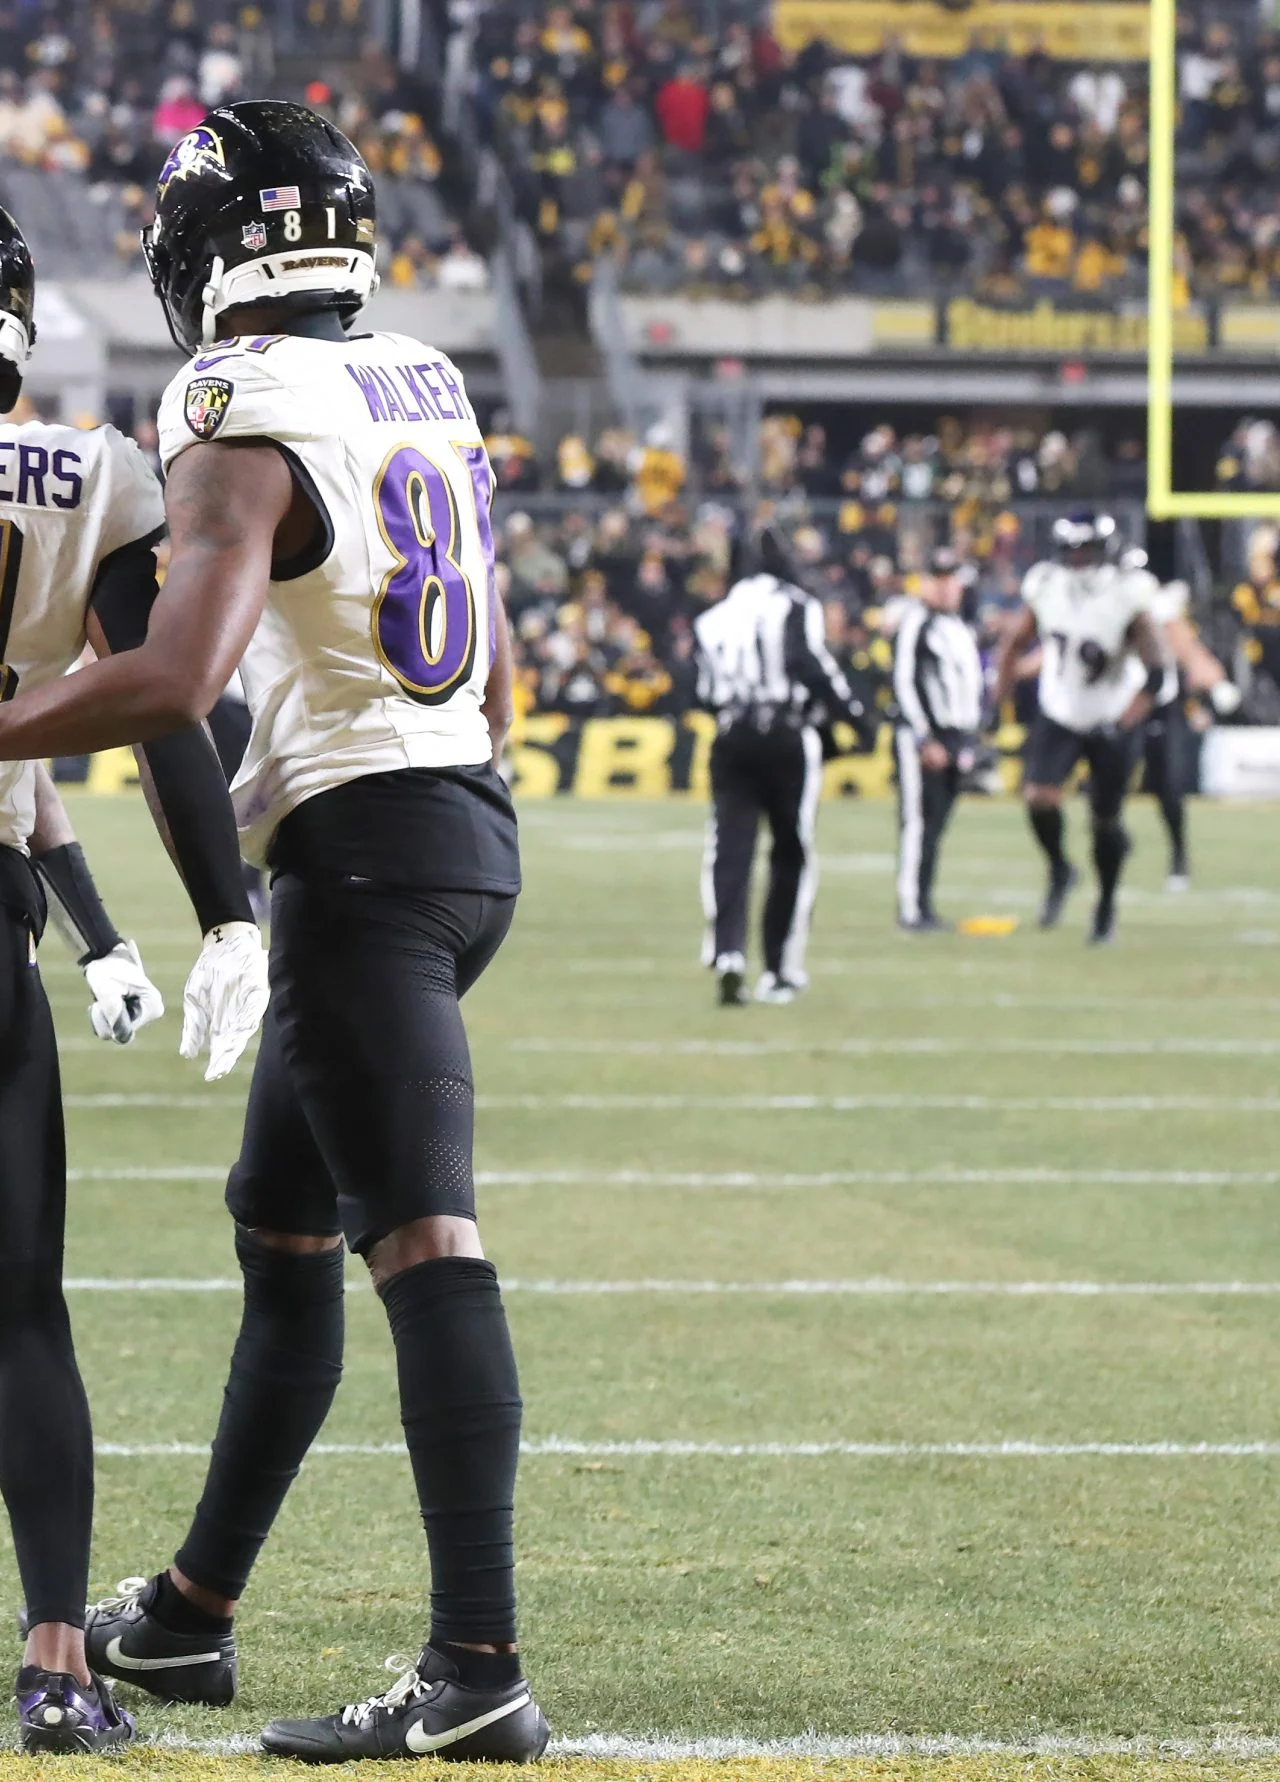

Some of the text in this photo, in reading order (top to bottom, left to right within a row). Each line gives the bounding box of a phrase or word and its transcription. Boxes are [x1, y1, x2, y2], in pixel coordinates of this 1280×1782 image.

[281, 256, 349, 272] RAVENS
[190, 379, 229, 390] RAVENS
[344, 362, 471, 422] WALKER
